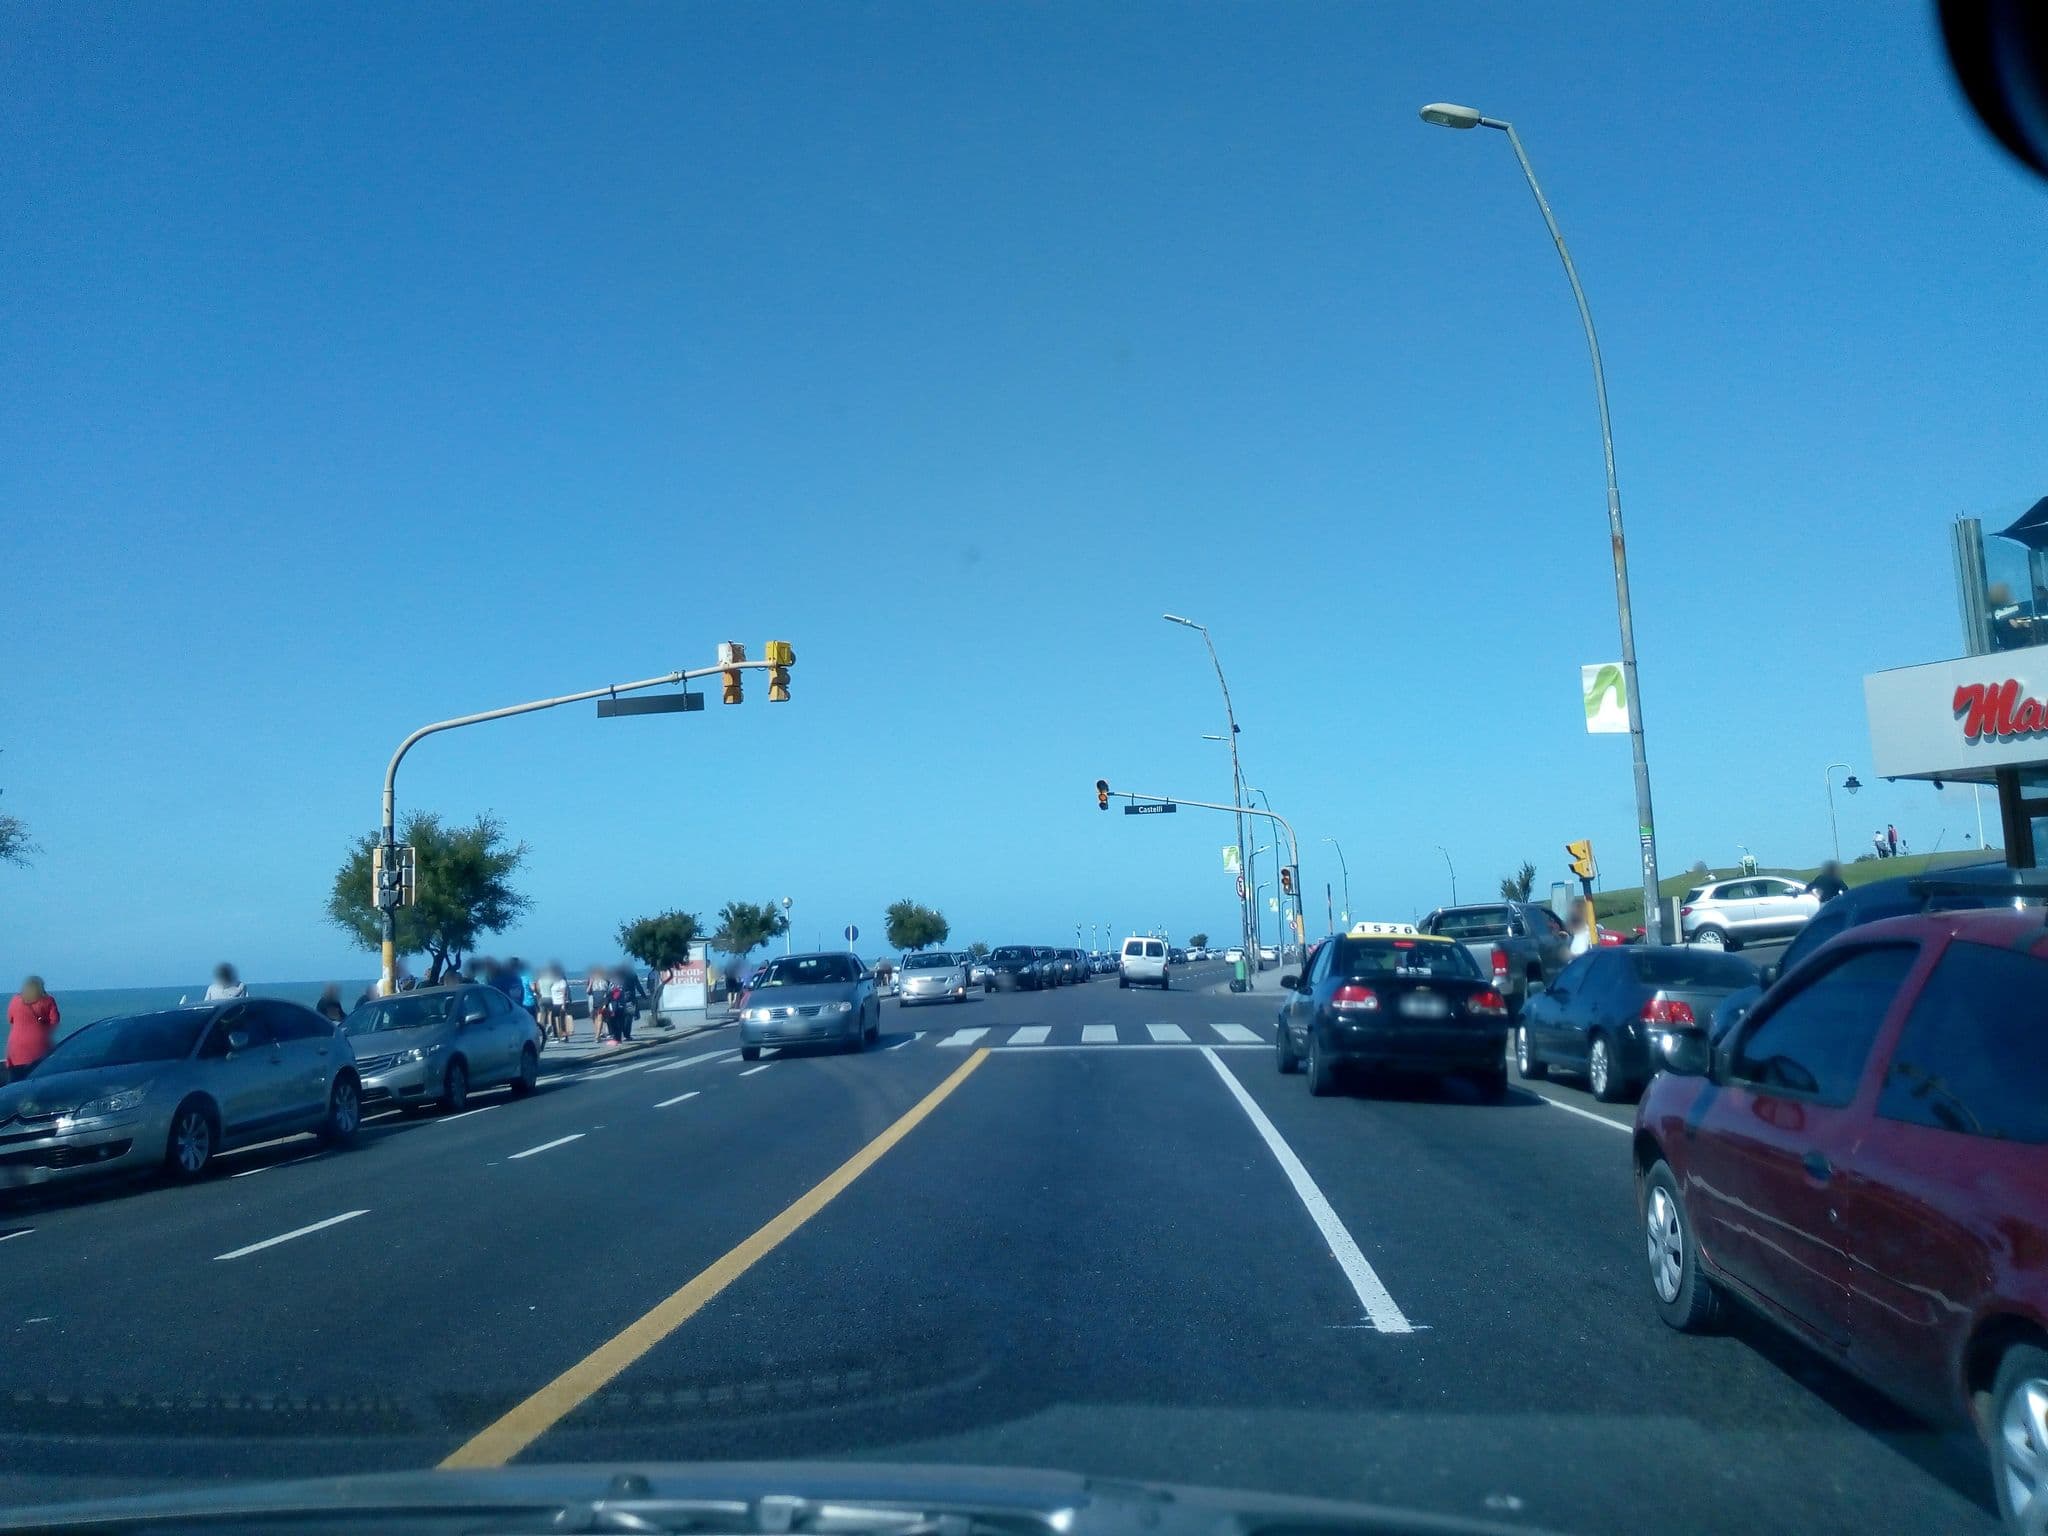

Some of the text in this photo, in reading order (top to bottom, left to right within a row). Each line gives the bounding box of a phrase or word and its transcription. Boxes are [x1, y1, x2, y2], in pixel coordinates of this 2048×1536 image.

[1953, 679, 2048, 738] Ma
[1138, 805, 1163, 814] Castelli
[1359, 924, 1412, 934] 1526
